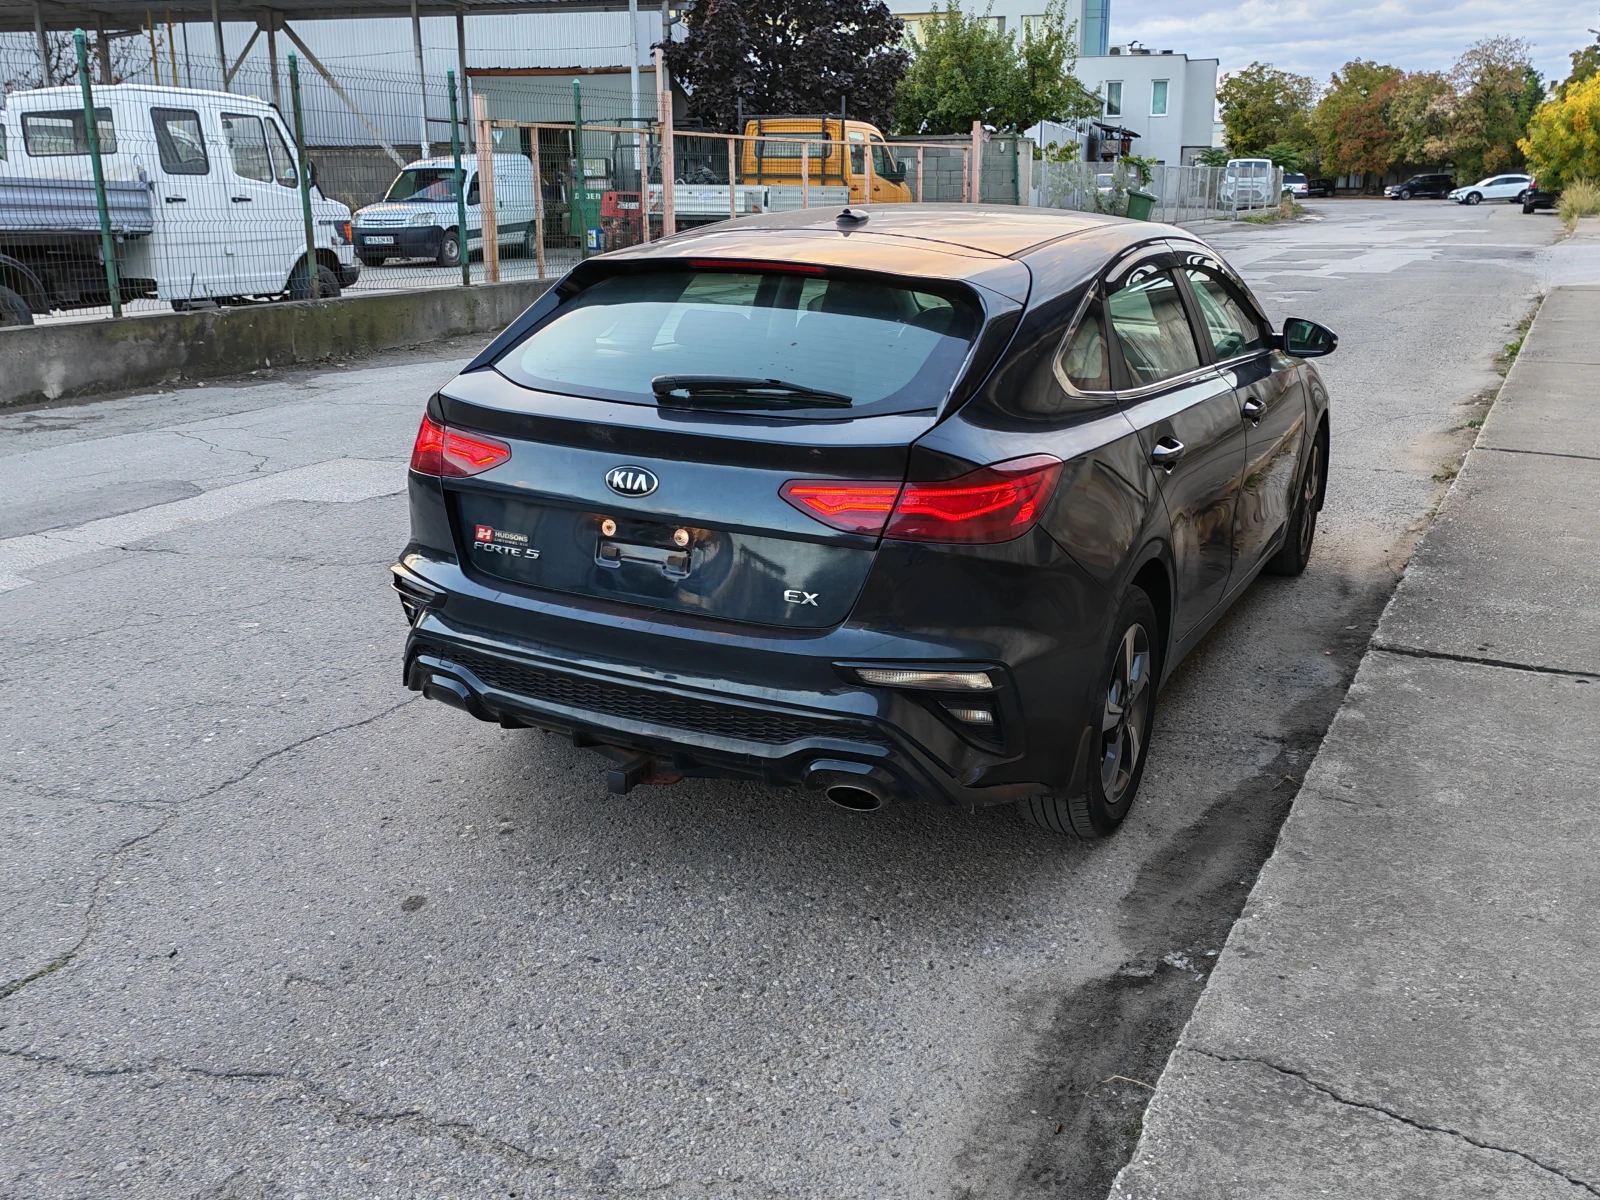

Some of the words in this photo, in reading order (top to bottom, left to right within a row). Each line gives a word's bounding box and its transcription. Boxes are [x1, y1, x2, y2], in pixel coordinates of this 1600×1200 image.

[612, 470, 648, 492] KIA
[494, 531, 528, 542] HUDSONS
[474, 541, 521, 557] FORTE
[524, 548, 540, 560] 5
[783, 589, 819, 607] EX
